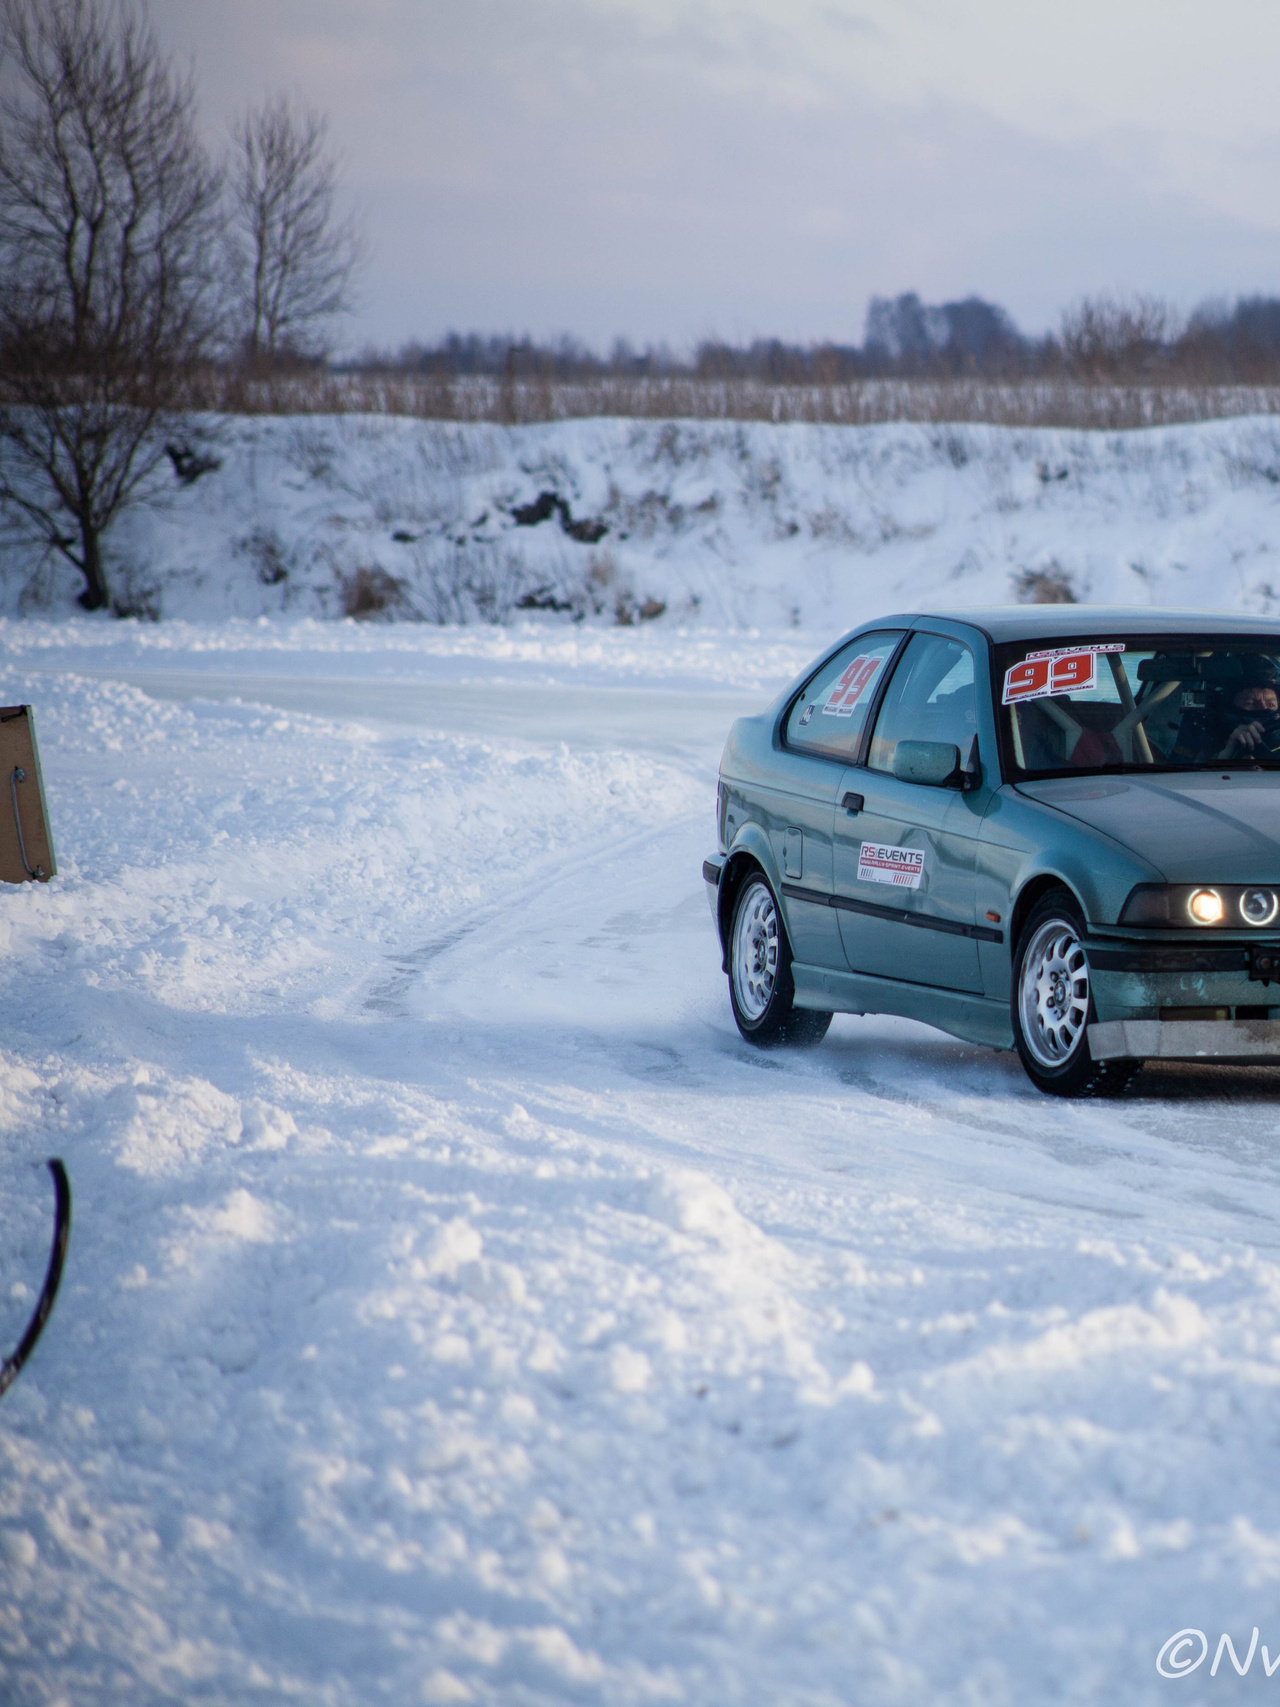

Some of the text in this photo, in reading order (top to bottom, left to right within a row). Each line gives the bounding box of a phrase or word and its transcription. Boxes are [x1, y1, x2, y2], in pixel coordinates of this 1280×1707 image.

[828, 657, 882, 707] 99
[1006, 653, 1093, 698] 99
[861, 846, 923, 864] RS EVENTS
